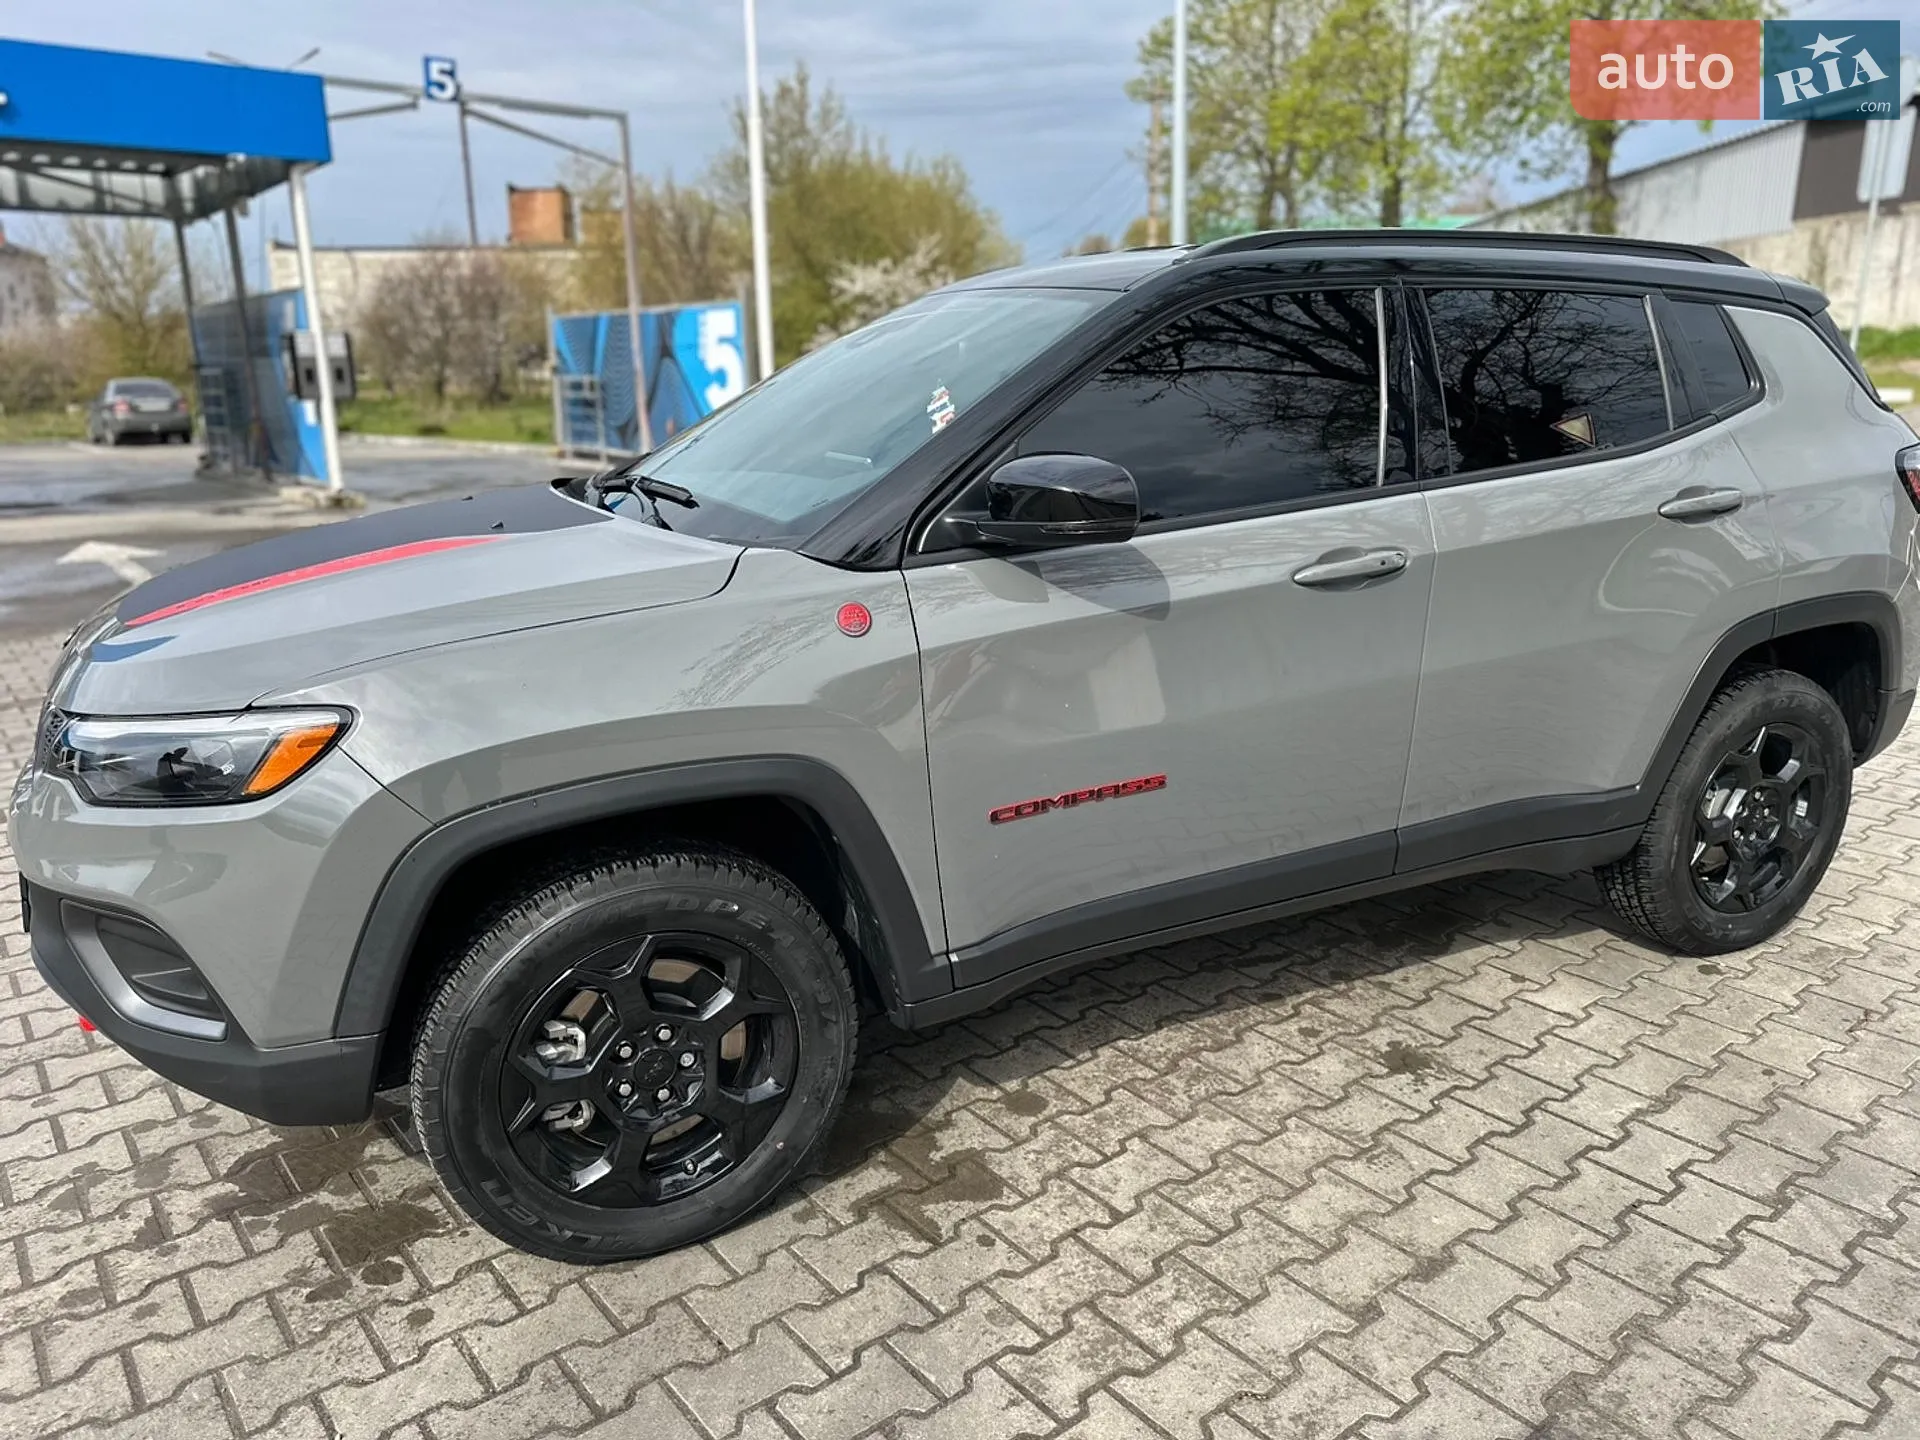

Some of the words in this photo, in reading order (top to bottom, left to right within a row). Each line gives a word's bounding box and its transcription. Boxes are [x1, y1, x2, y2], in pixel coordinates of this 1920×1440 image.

[429, 61, 454, 99] 5
[704, 308, 744, 411] 5
[988, 772, 1168, 825] COMPASS
